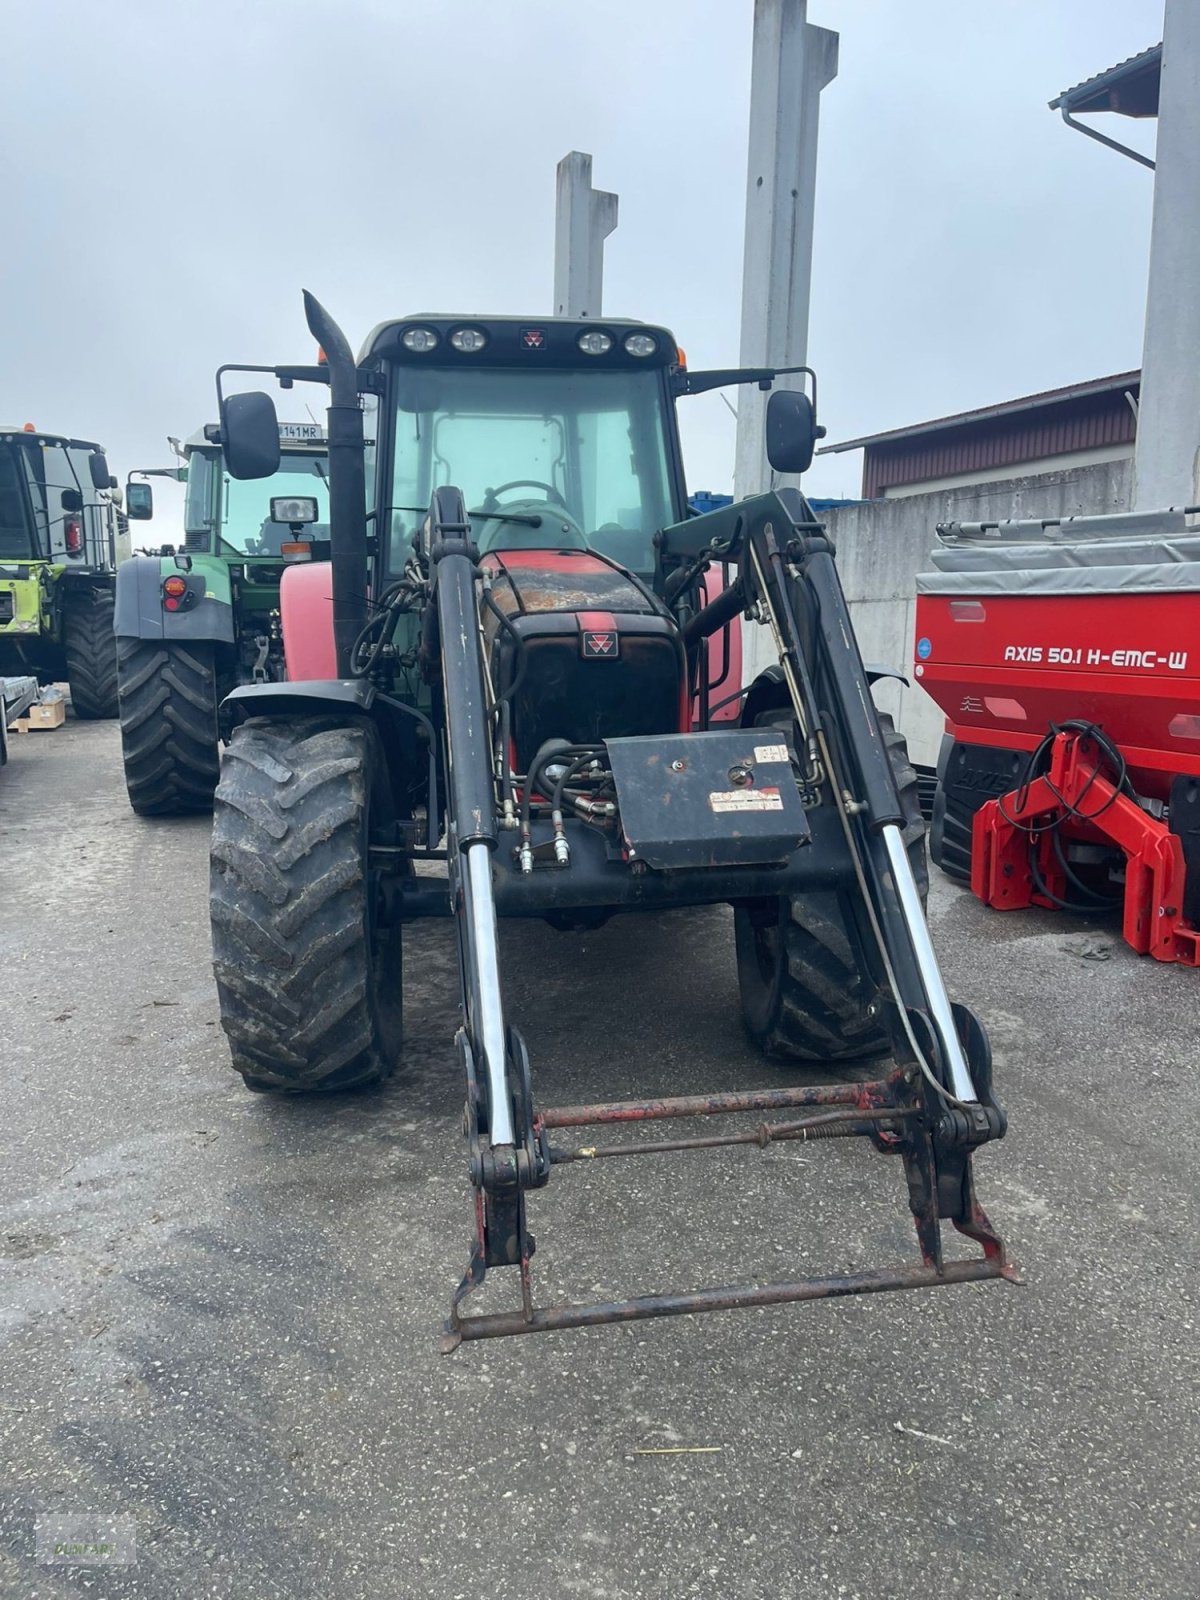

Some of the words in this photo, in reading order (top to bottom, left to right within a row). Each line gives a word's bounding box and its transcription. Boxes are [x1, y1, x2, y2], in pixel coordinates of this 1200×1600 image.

[1004, 646, 1043, 662] AXIS
[1047, 647, 1082, 664] 50.1
[1087, 649, 1187, 670] H-EMC-W
[953, 768, 1013, 794] AXIS
